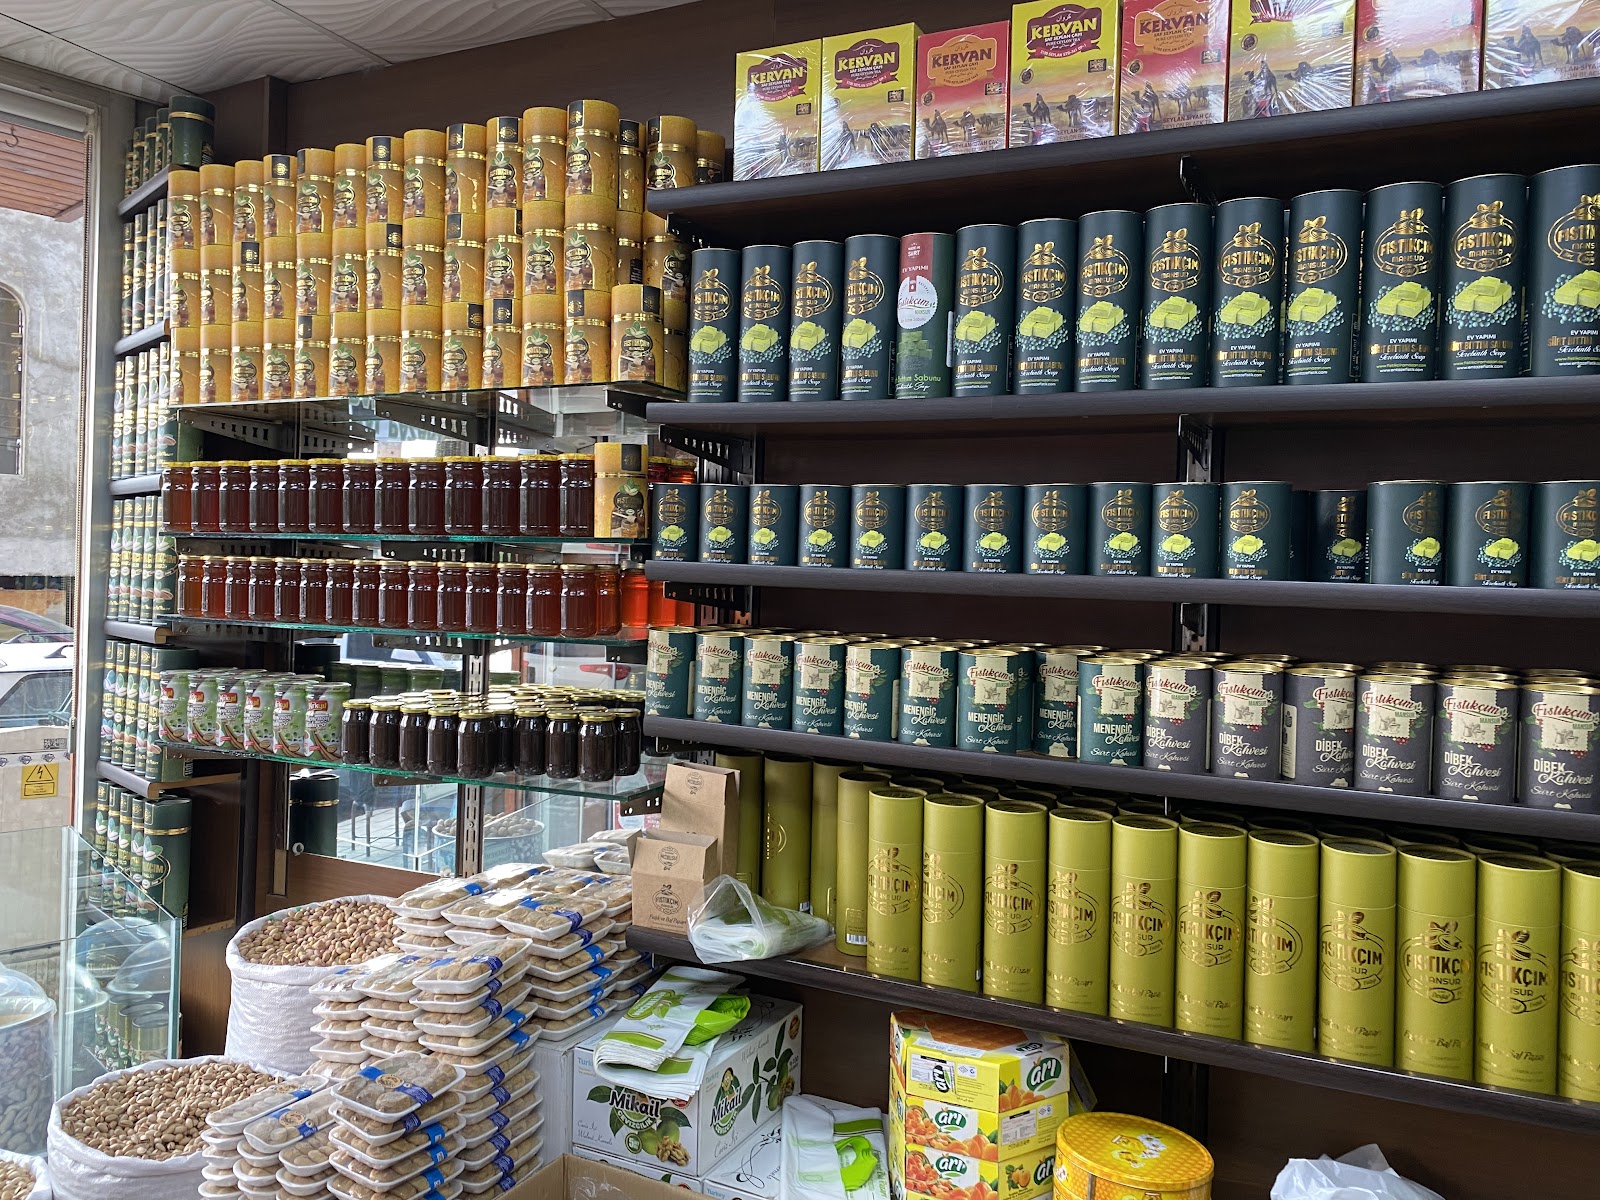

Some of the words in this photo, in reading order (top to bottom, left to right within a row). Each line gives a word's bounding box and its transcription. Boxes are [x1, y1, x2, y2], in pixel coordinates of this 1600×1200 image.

[1031, 17, 1098, 40] KERVAN
[1140, 12, 1210, 35] KERVAN
[838, 52, 896, 71] KERVAN
[931, 48, 992, 68] KERVAN
[750, 67, 803, 85] KERVAN
[1380, 238, 1433, 256] FISTIKÇIM
[1457, 232, 1514, 251] FISTIKÇIM
[1222, 251, 1273, 268] FISTIKÇIM
[1392, 255, 1425, 263] MANSUR
[1470, 249, 1503, 258] MANSUR
[1151, 256, 1199, 273] FISTIKÇIM
[1296, 262, 1325, 270] MANSUR
[1022, 268, 1066, 283] FISTIKÇIM
[914, 373, 941, 382] Sabunu
[969, 666, 1010, 680] Fıstıkçım
[1093, 675, 1138, 689] Fıstıkçım
[697, 684, 727, 696] MENENGİÇ
[747, 690, 778, 703] MENENGİÇ
[1219, 681, 1266, 698] Fıstıkçım
[704, 691, 737, 703] Kahvesi
[754, 697, 787, 710] Kahvesi
[796, 695, 827, 709] MENENGİÇ
[1363, 692, 1414, 709] Fıstıkçım
[803, 702, 836, 716] Kahvesi
[903, 703, 937, 717] MENENGİÇ
[1444, 697, 1501, 714] Fıstıkçım
[1533, 703, 1593, 721] Fıstıkçım
[847, 709, 879, 721] Kahvesi
[910, 711, 947, 725] Kahvesi
[967, 711, 1004, 724] MENENGİÇ
[1039, 708, 1074, 720] MENENGİÇ
[978, 719, 1013, 734] Kahvesi
[1093, 722, 1133, 735] MENENGİÇ
[1146, 724, 1166, 738] DİBEK
[1148, 735, 1192, 749] Kahvesi
[1219, 732, 1244, 745] DİBEK
[1315, 738, 1342, 751] DİBEK
[1222, 742, 1269, 756] Kahvesi
[1362, 744, 1389, 758] DİBEK
[1365, 755, 1417, 770] Kahvesi
[1444, 751, 1474, 767] DİBEK
[1533, 757, 1566, 774] DİBEK
[1448, 763, 1502, 778] Kahvesi
[1441, 778, 1463, 789] Siirt
[1464, 781, 1501, 792] Kahvesi
[1537, 770, 1594, 786] Kahvesi
[1530, 786, 1555, 798] Siirt
[1556, 789, 1592, 801] Kahvesi
[1319, 940, 1381, 966] FISTIKÇIM
[609, 1090, 661, 1118] Mikail
[710, 1086, 743, 1127] Mikail
